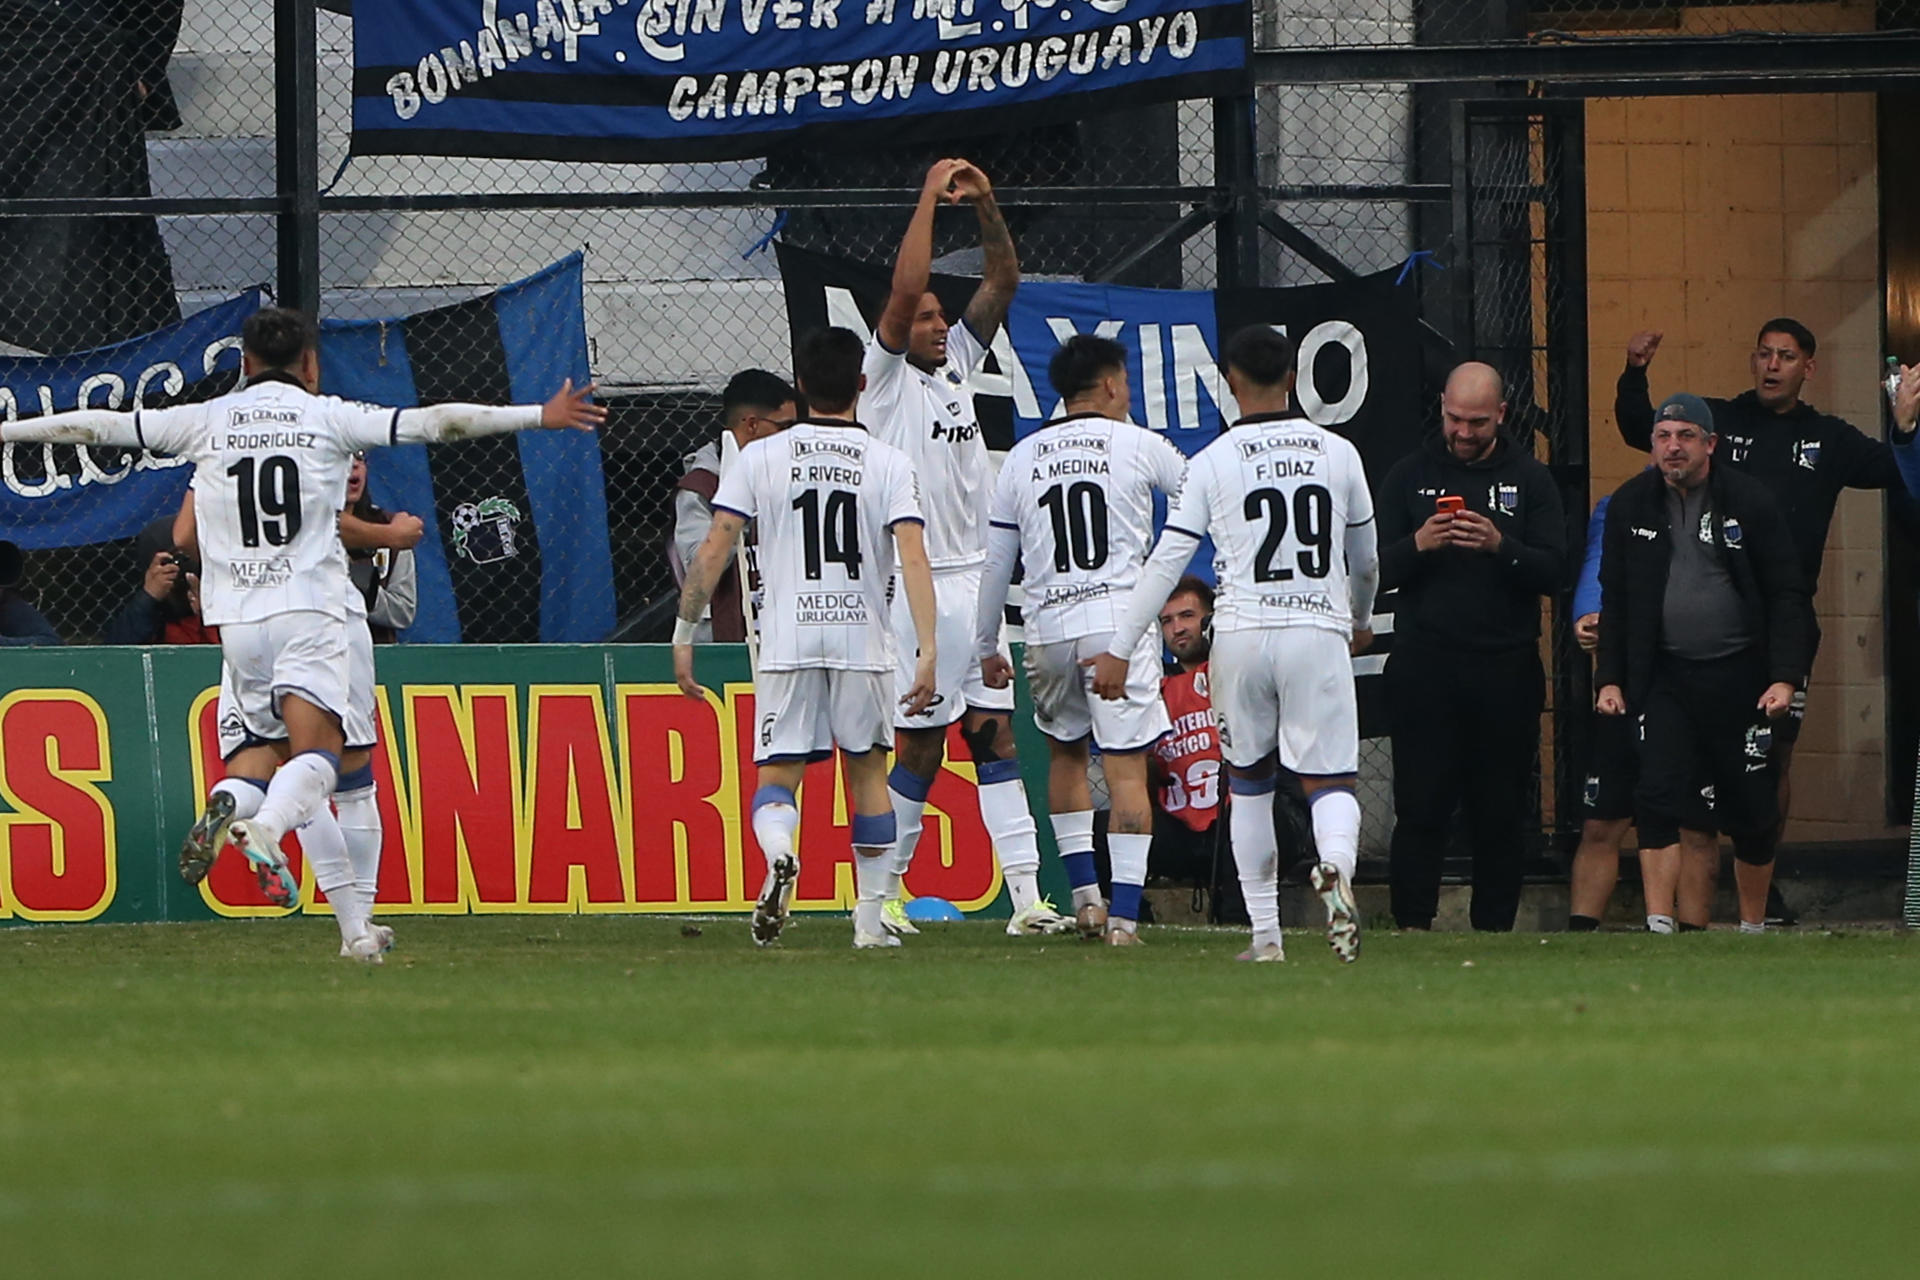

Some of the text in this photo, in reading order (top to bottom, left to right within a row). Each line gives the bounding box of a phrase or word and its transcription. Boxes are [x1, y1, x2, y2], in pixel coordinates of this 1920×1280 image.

[667, 54, 919, 121] CAMPEON
[931, 11, 1198, 95] URUGUAYO
[227, 455, 302, 548] 19
[808, 466, 862, 486] RIVERO
[1049, 459, 1110, 478] MEDINA
[1256, 456, 1315, 480] F. DÍAZ
[792, 488, 863, 580] 14
[1038, 481, 1108, 573] 10
[1243, 484, 1332, 583] 29
[796, 594, 866, 610] MEDICA
[796, 610, 868, 623] URUGUAYA
[0, 688, 118, 922] S
